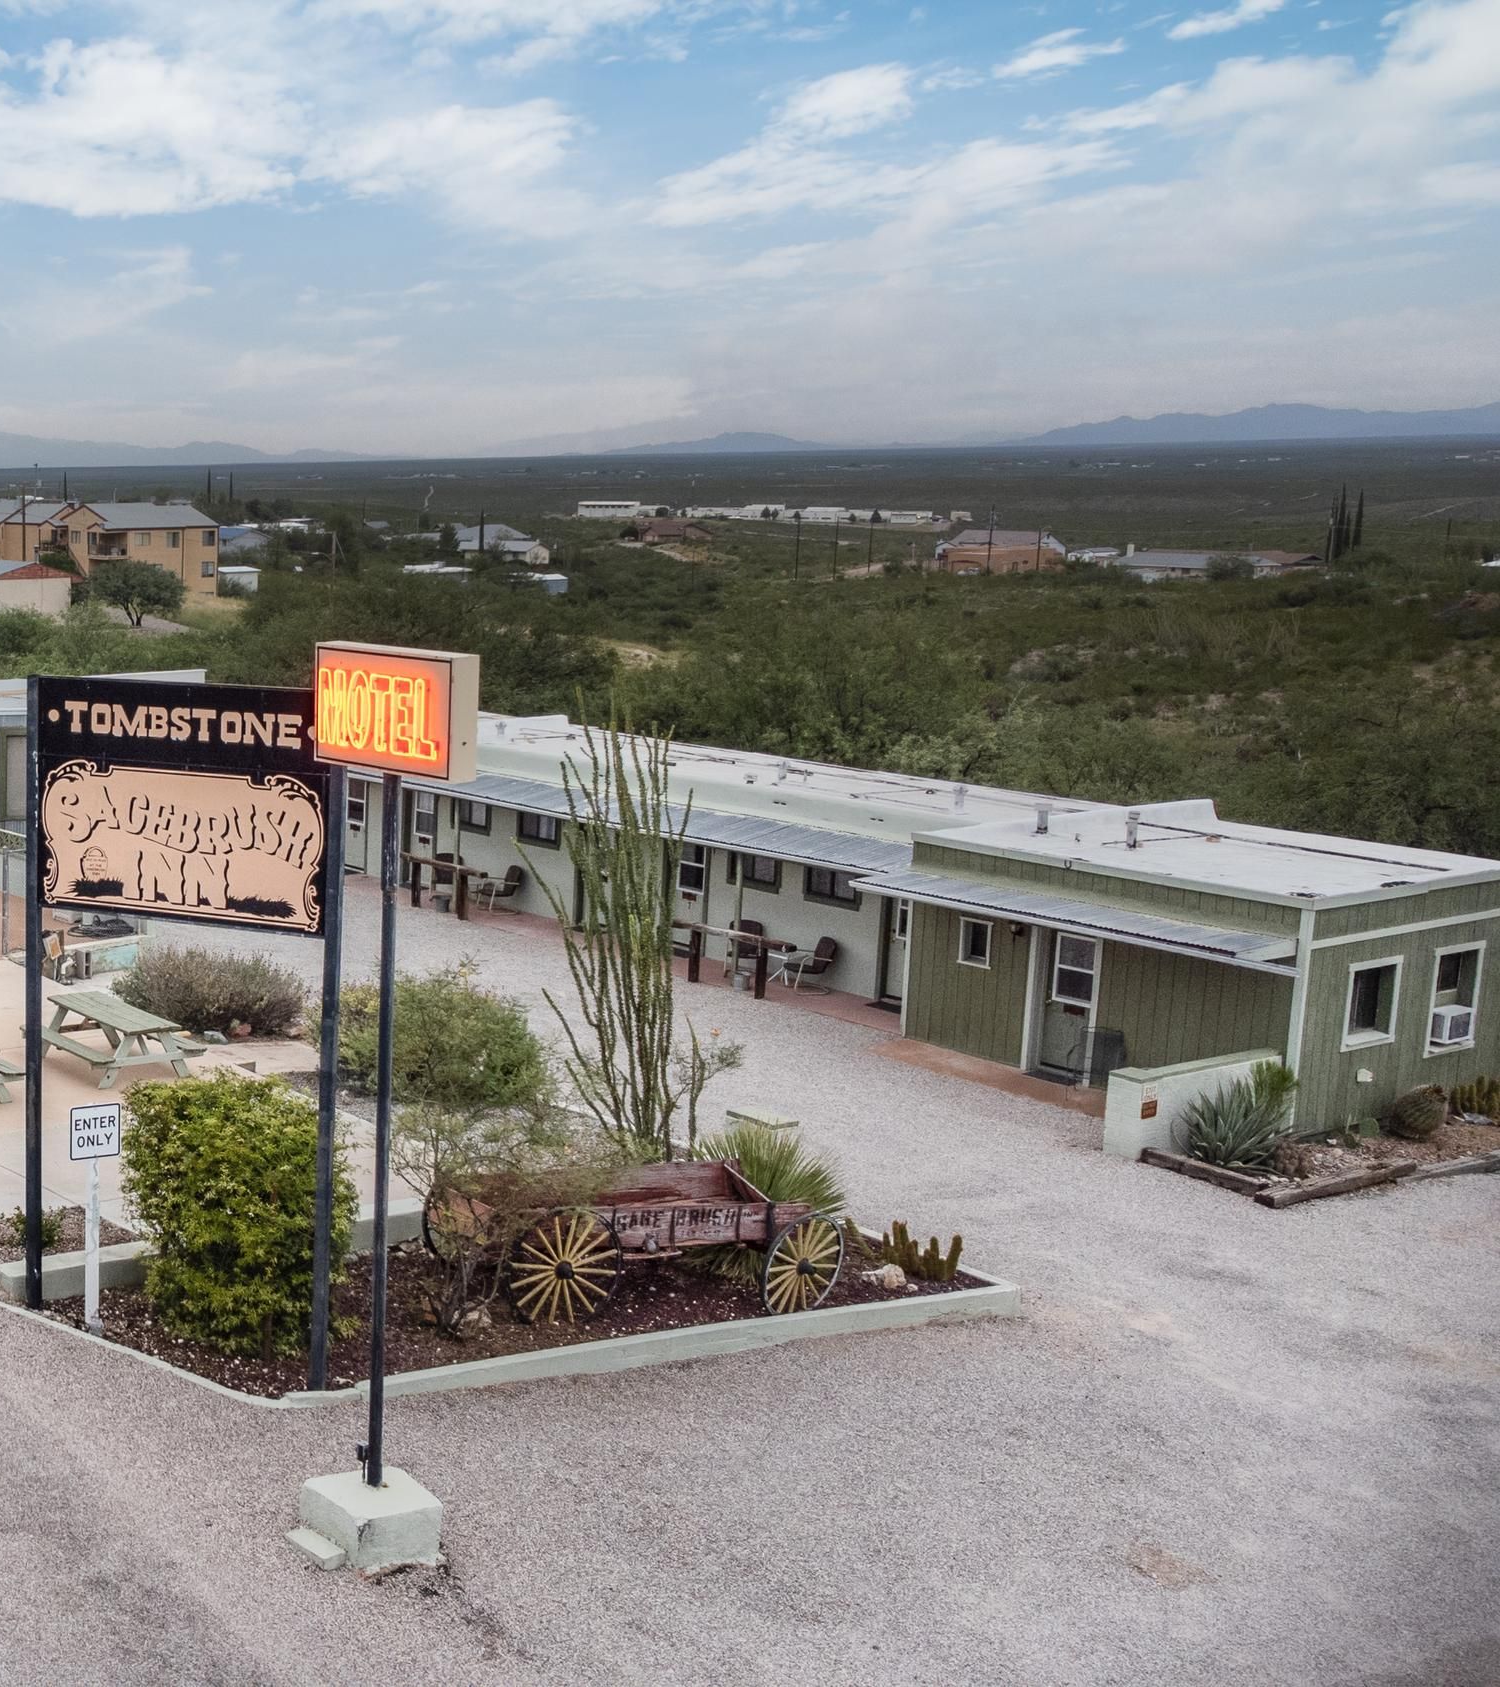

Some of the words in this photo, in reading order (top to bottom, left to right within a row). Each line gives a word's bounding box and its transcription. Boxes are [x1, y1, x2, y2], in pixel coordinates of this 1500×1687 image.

[64, 700, 303, 750] TOMBSTONE
[318, 667, 438, 760] MOTEL
[57, 785, 314, 870] SAGEBRUSH
[124, 850, 231, 910] INN
[74, 1115, 116, 1131] ENTER
[77, 1132, 113, 1148] ONLY
[675, 1208, 736, 1227] BRUSH
